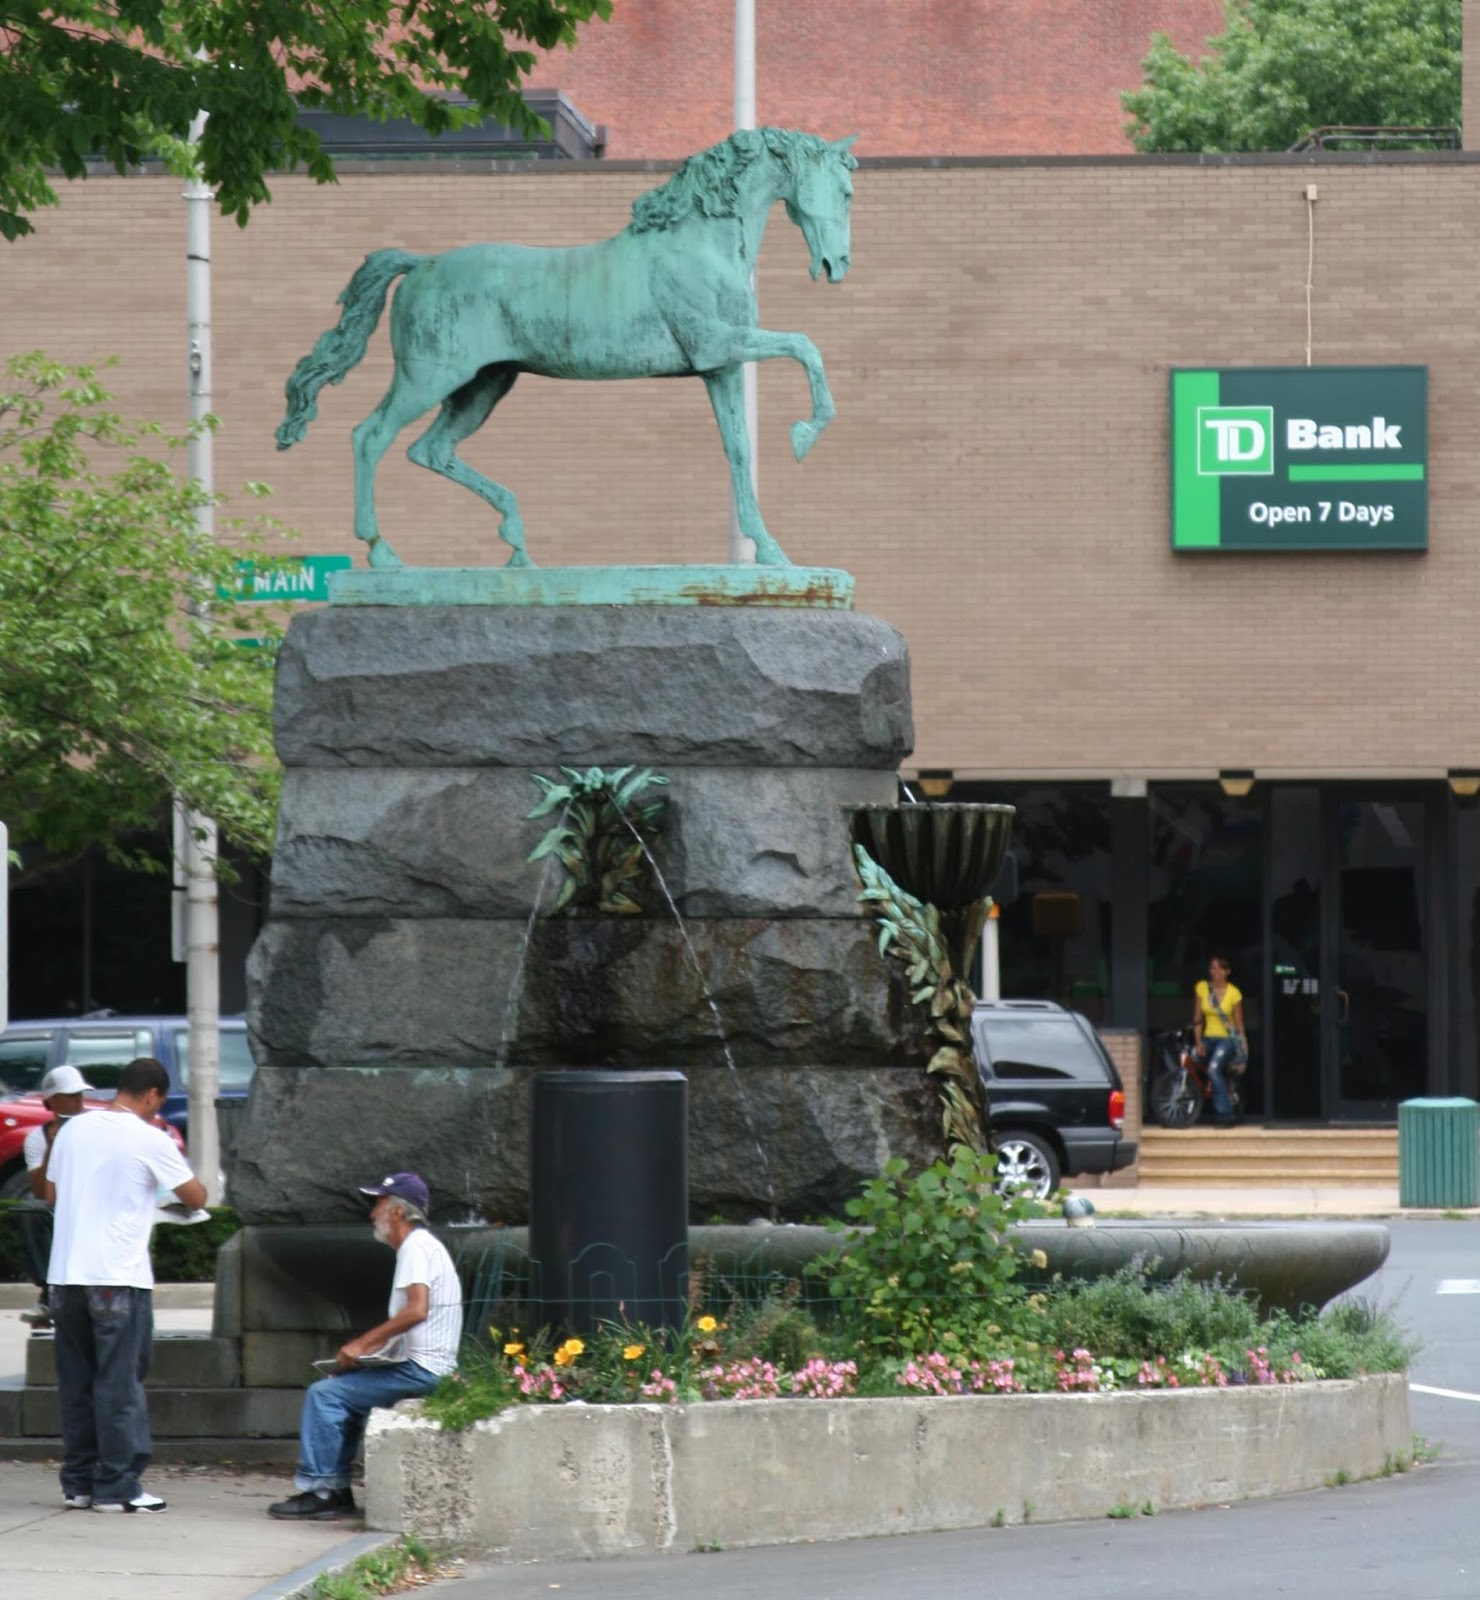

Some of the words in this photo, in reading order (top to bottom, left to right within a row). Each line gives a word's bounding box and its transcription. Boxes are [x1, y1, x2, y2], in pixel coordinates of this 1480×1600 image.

[1205, 419, 1265, 461] TD
[1287, 416, 1402, 449] Bank
[1249, 501, 1311, 527] Open
[1318, 501, 1332, 522] 7
[1339, 501, 1395, 527] Days
[254, 566, 315, 592] MAIN
